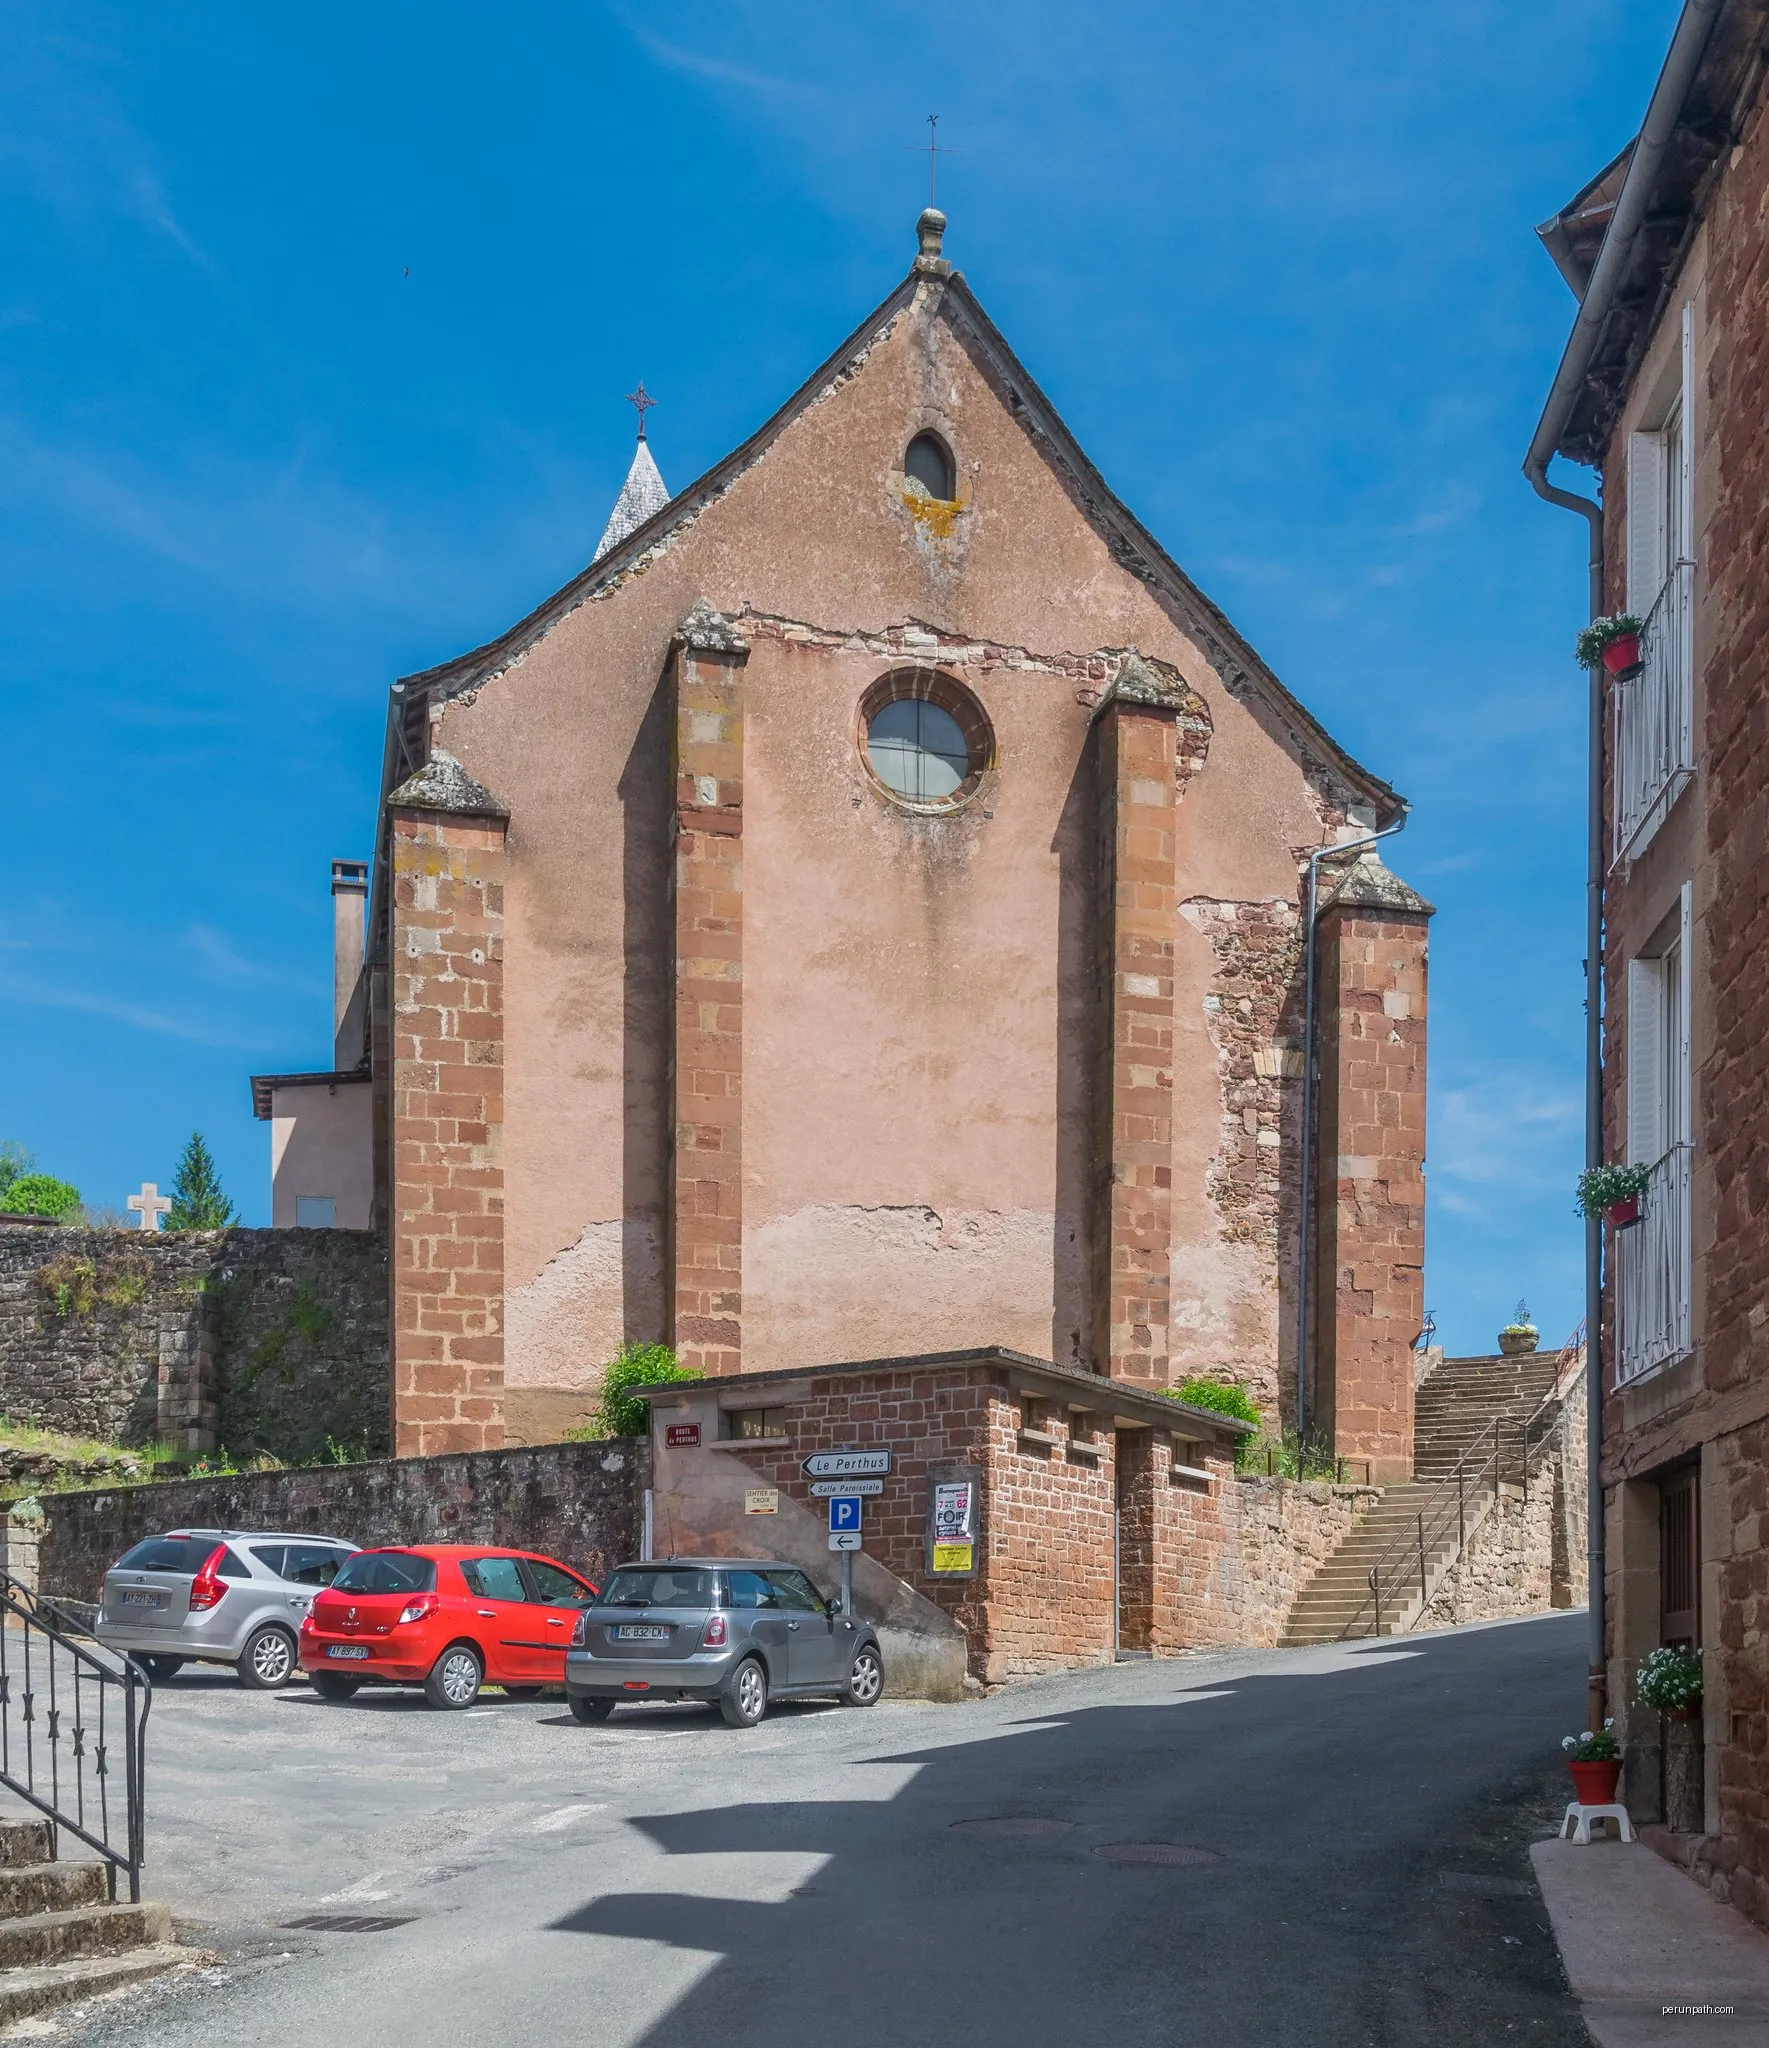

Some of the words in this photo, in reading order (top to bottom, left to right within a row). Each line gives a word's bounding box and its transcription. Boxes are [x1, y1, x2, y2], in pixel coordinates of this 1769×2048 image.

[816, 1459, 830, 1471] Le
[836, 1457, 884, 1470] Perthus
[818, 1485, 837, 1493] Salle
[839, 1483, 880, 1492] Paroissiale
[938, 1501, 944, 1509] 7
[838, 1503, 852, 1525] P
[937, 1510, 966, 1524] FOIR
